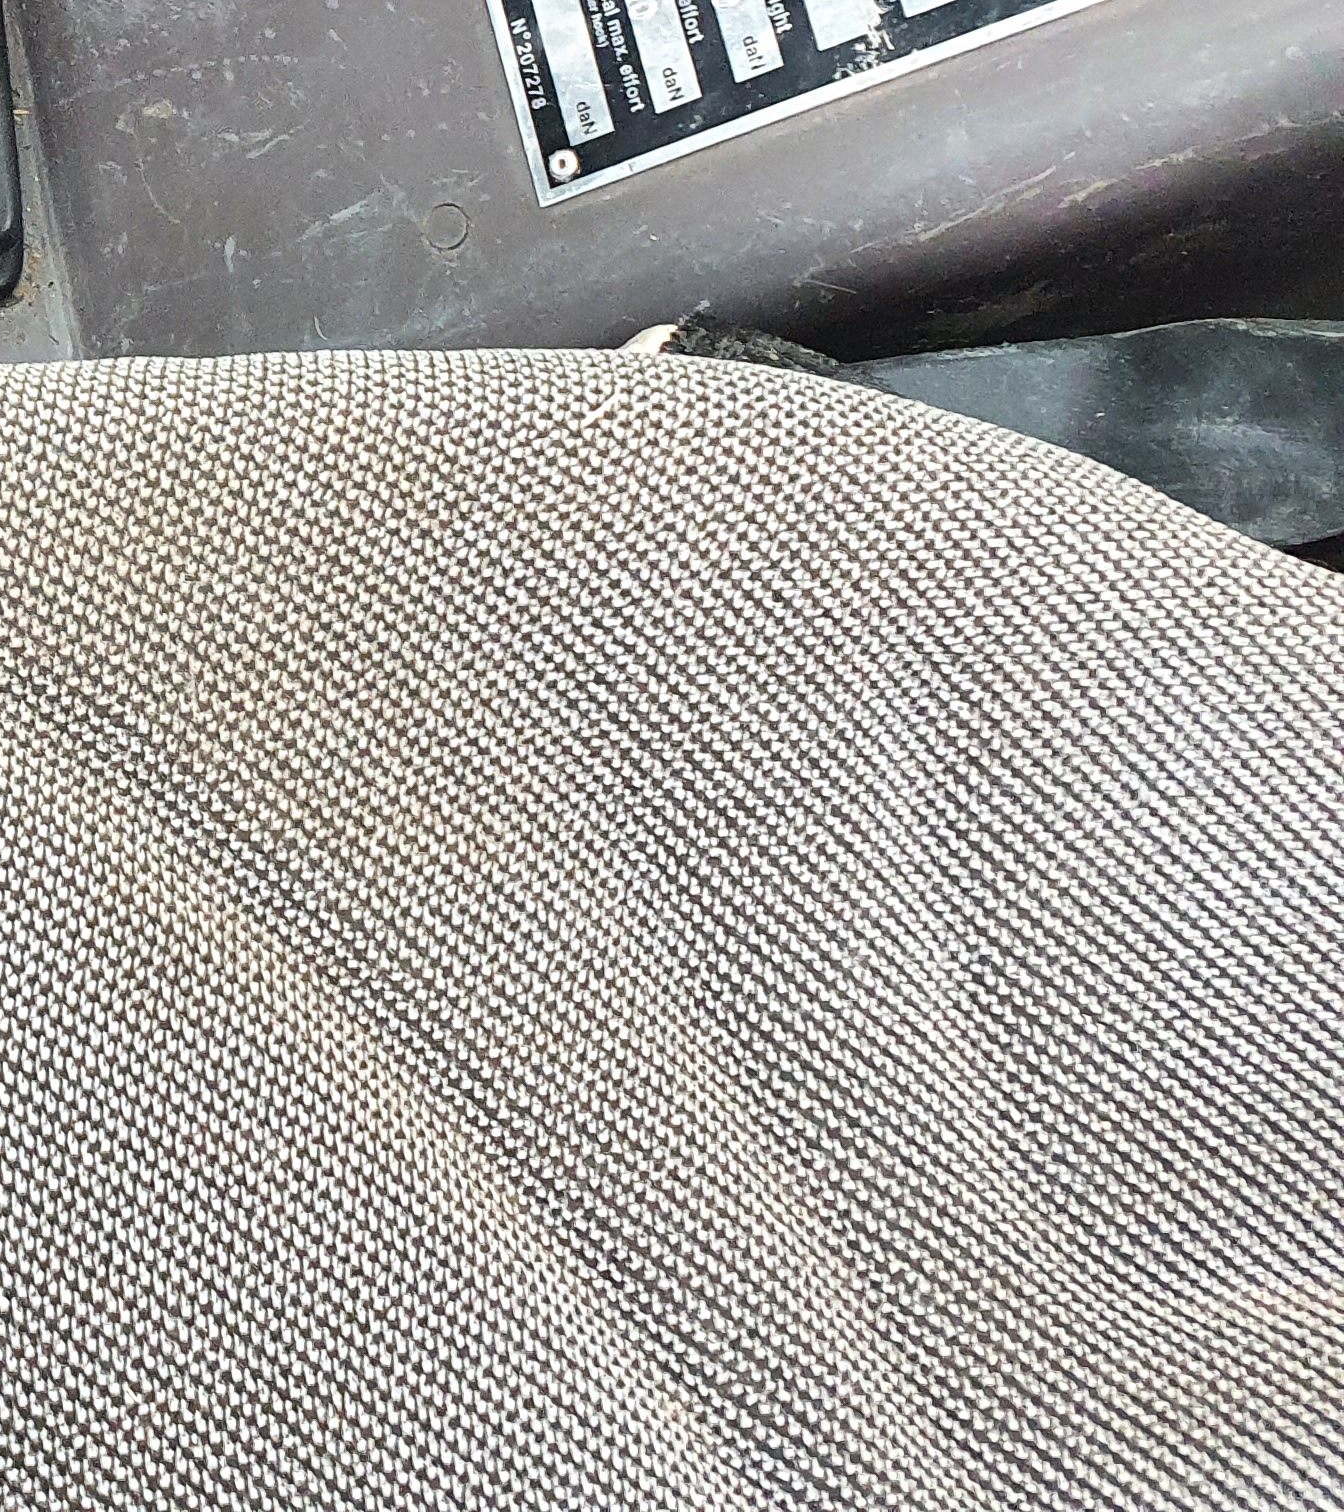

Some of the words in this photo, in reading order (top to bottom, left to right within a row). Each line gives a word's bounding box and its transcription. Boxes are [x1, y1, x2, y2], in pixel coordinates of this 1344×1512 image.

[590, 12, 609, 47] hook)
[606, 18, 628, 61] max.
[619, 64, 645, 112] effort
[661, 66, 684, 101] daN
[575, 100, 597, 135] daN
